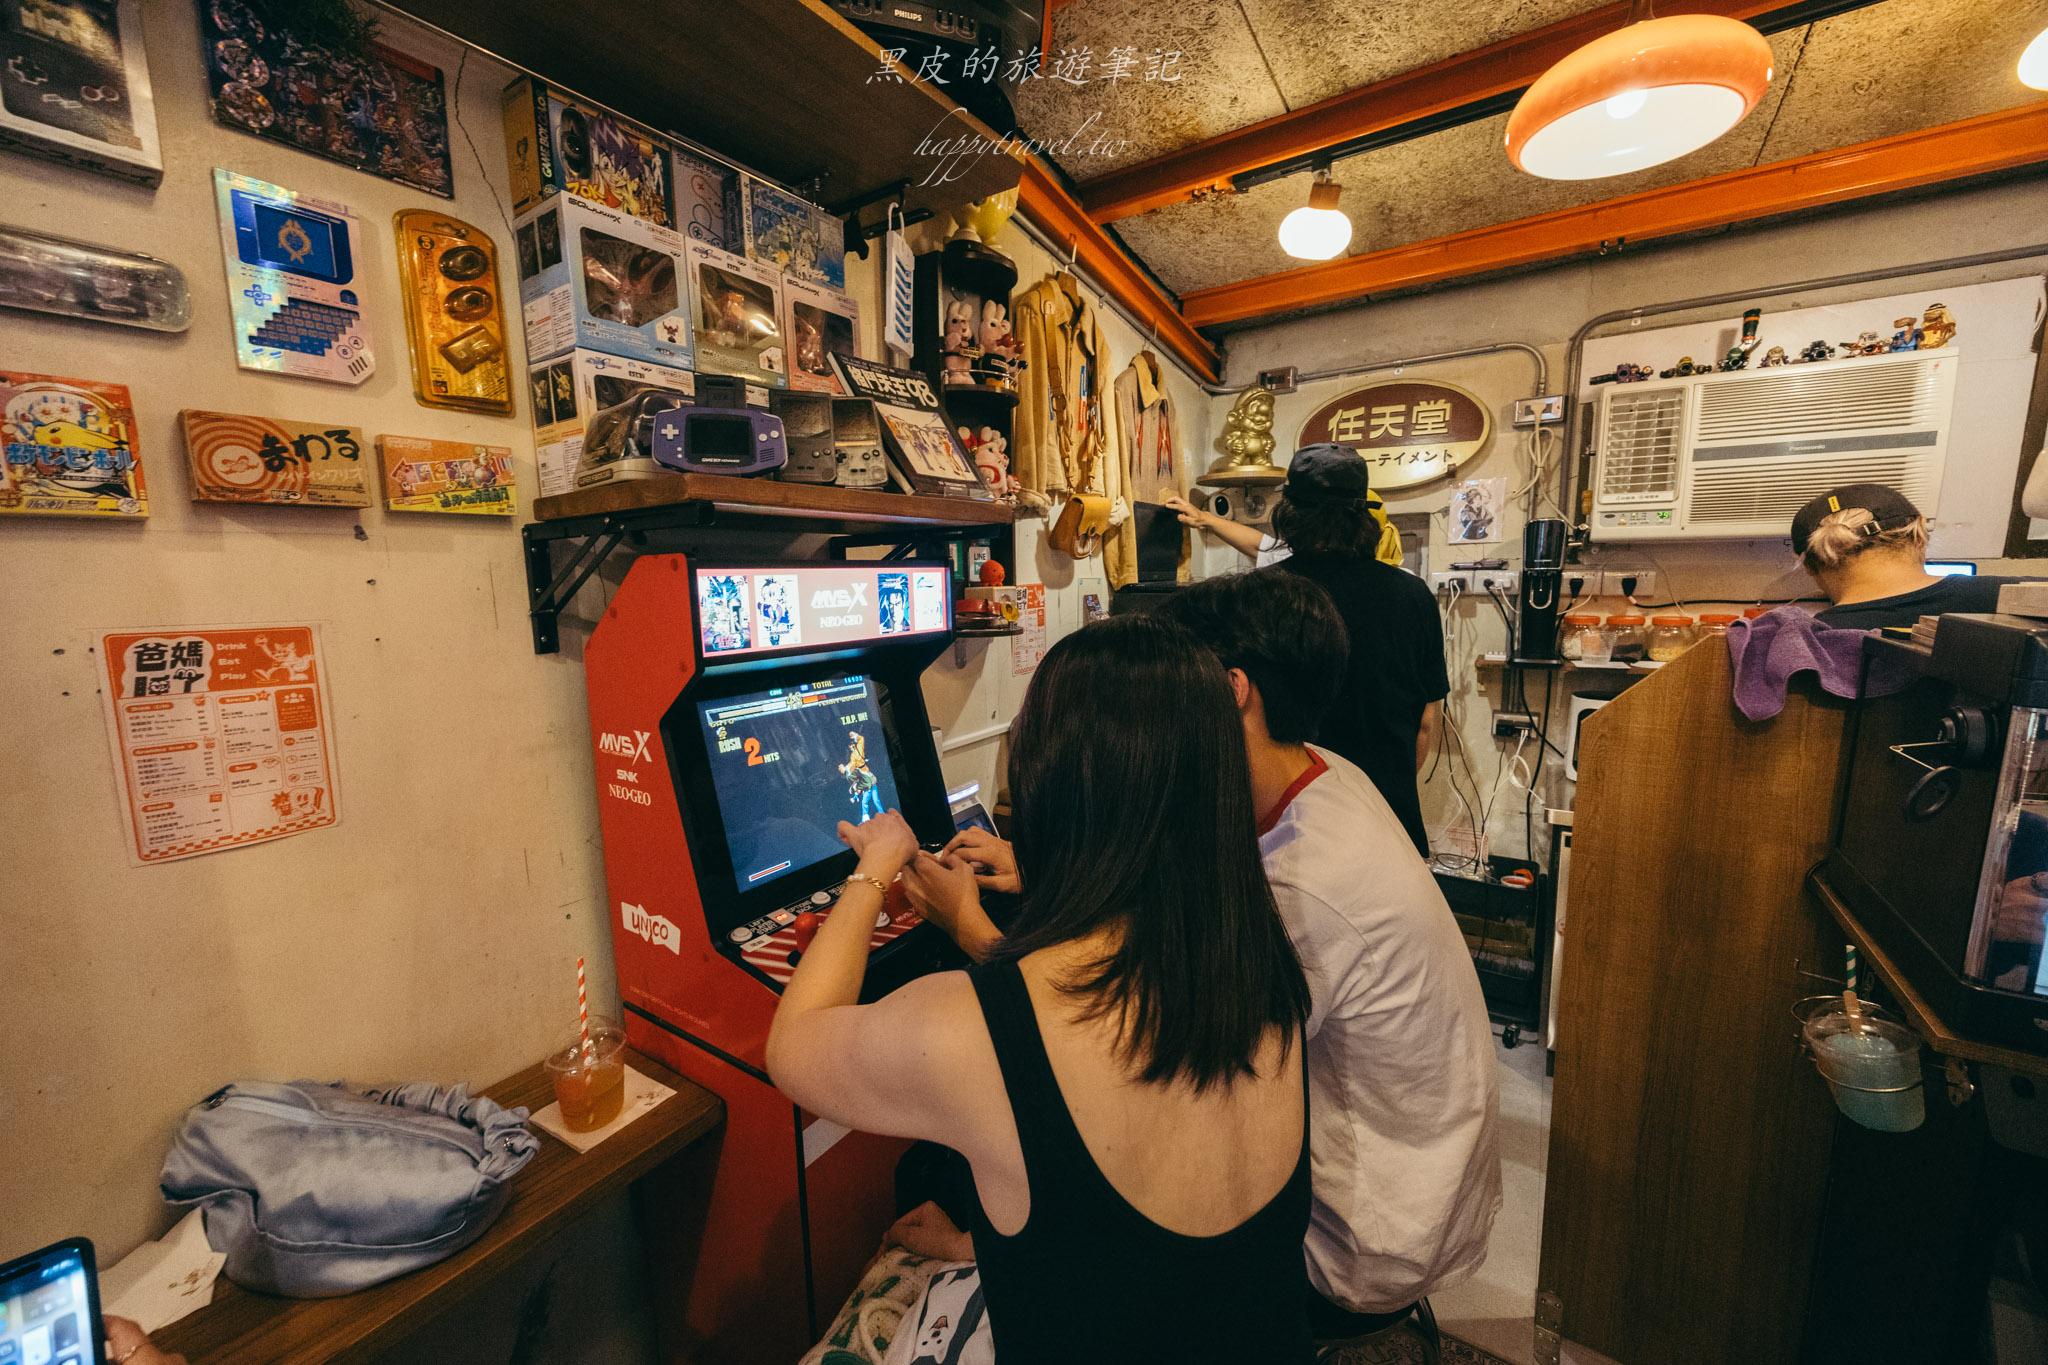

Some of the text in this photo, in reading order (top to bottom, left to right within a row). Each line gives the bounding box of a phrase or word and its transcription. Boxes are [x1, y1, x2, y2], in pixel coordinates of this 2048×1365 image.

[894, 9, 923, 22] PHILIPS
[1328, 398, 1453, 442] 任天堂
[258, 429, 360, 473] まわる
[974, 552, 986, 560] LINE
[216, 642, 247, 651] Drink
[134, 640, 204, 673] 爸媽
[218, 657, 241, 666] Eat
[219, 672, 247, 681] Play
[811, 680, 834, 690] TOTAL
[599, 730, 652, 767] MVSX
[718, 737, 742, 754] RUSH
[743, 736, 764, 767] 2
[616, 769, 639, 784] SNK
[631, 911, 669, 941] UNICO
